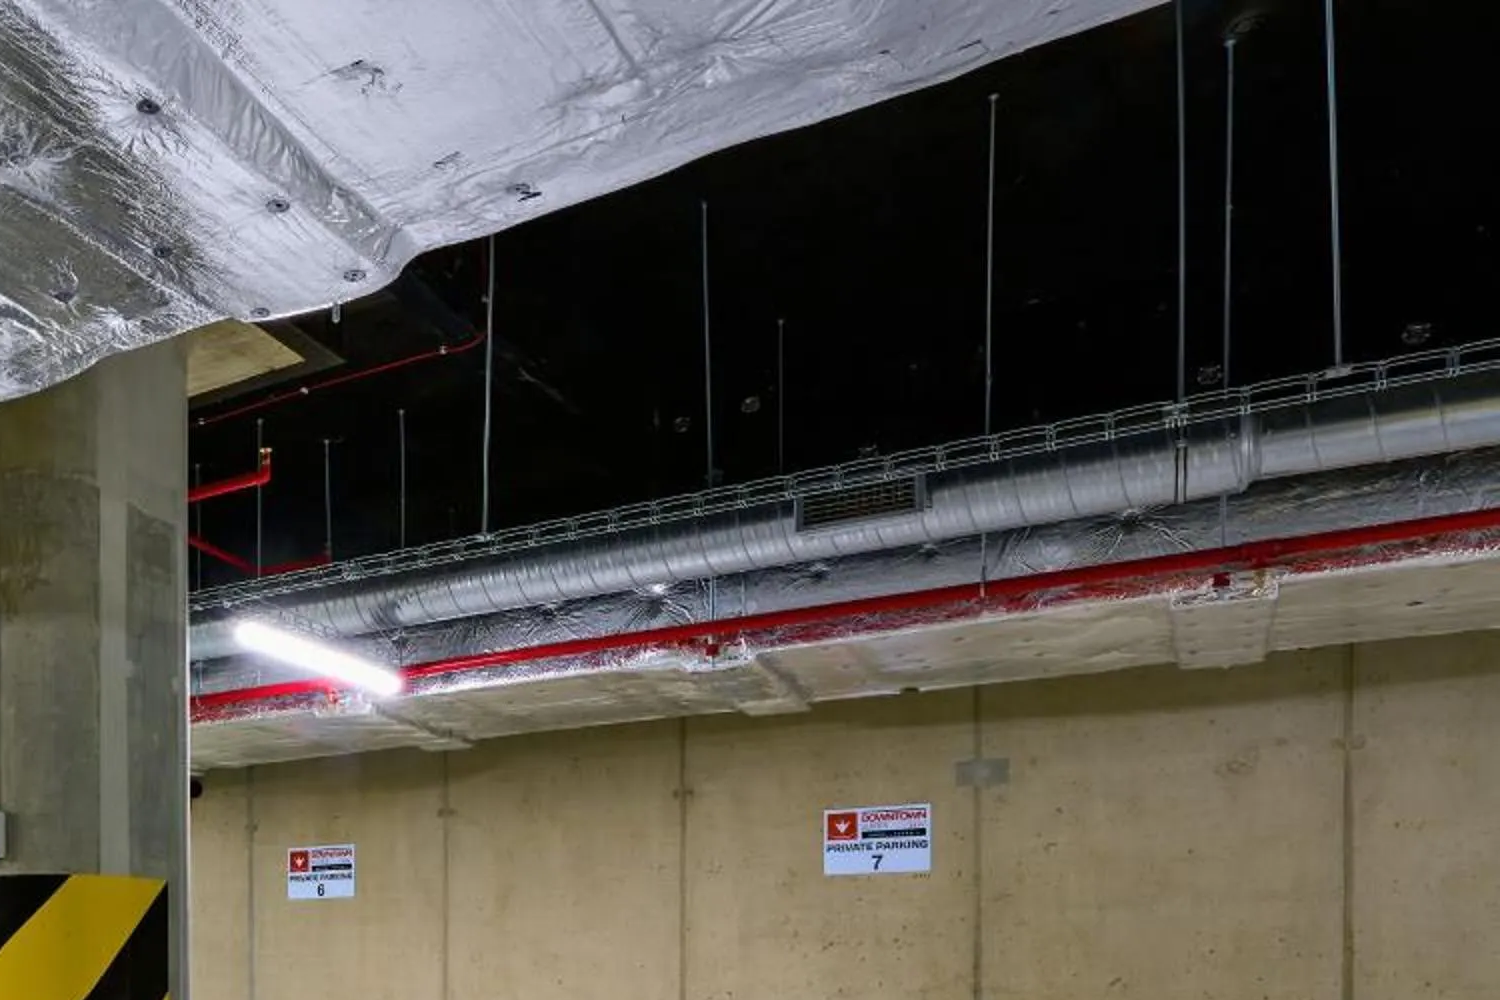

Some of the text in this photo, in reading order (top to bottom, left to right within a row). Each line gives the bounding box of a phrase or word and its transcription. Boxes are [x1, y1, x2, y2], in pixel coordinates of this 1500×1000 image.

[861, 809, 927, 822] DOWNTOWN
[826, 839, 928, 853] PRIVATE PARKING
[871, 854, 883, 870] 7
[317, 883, 325, 897] 6
